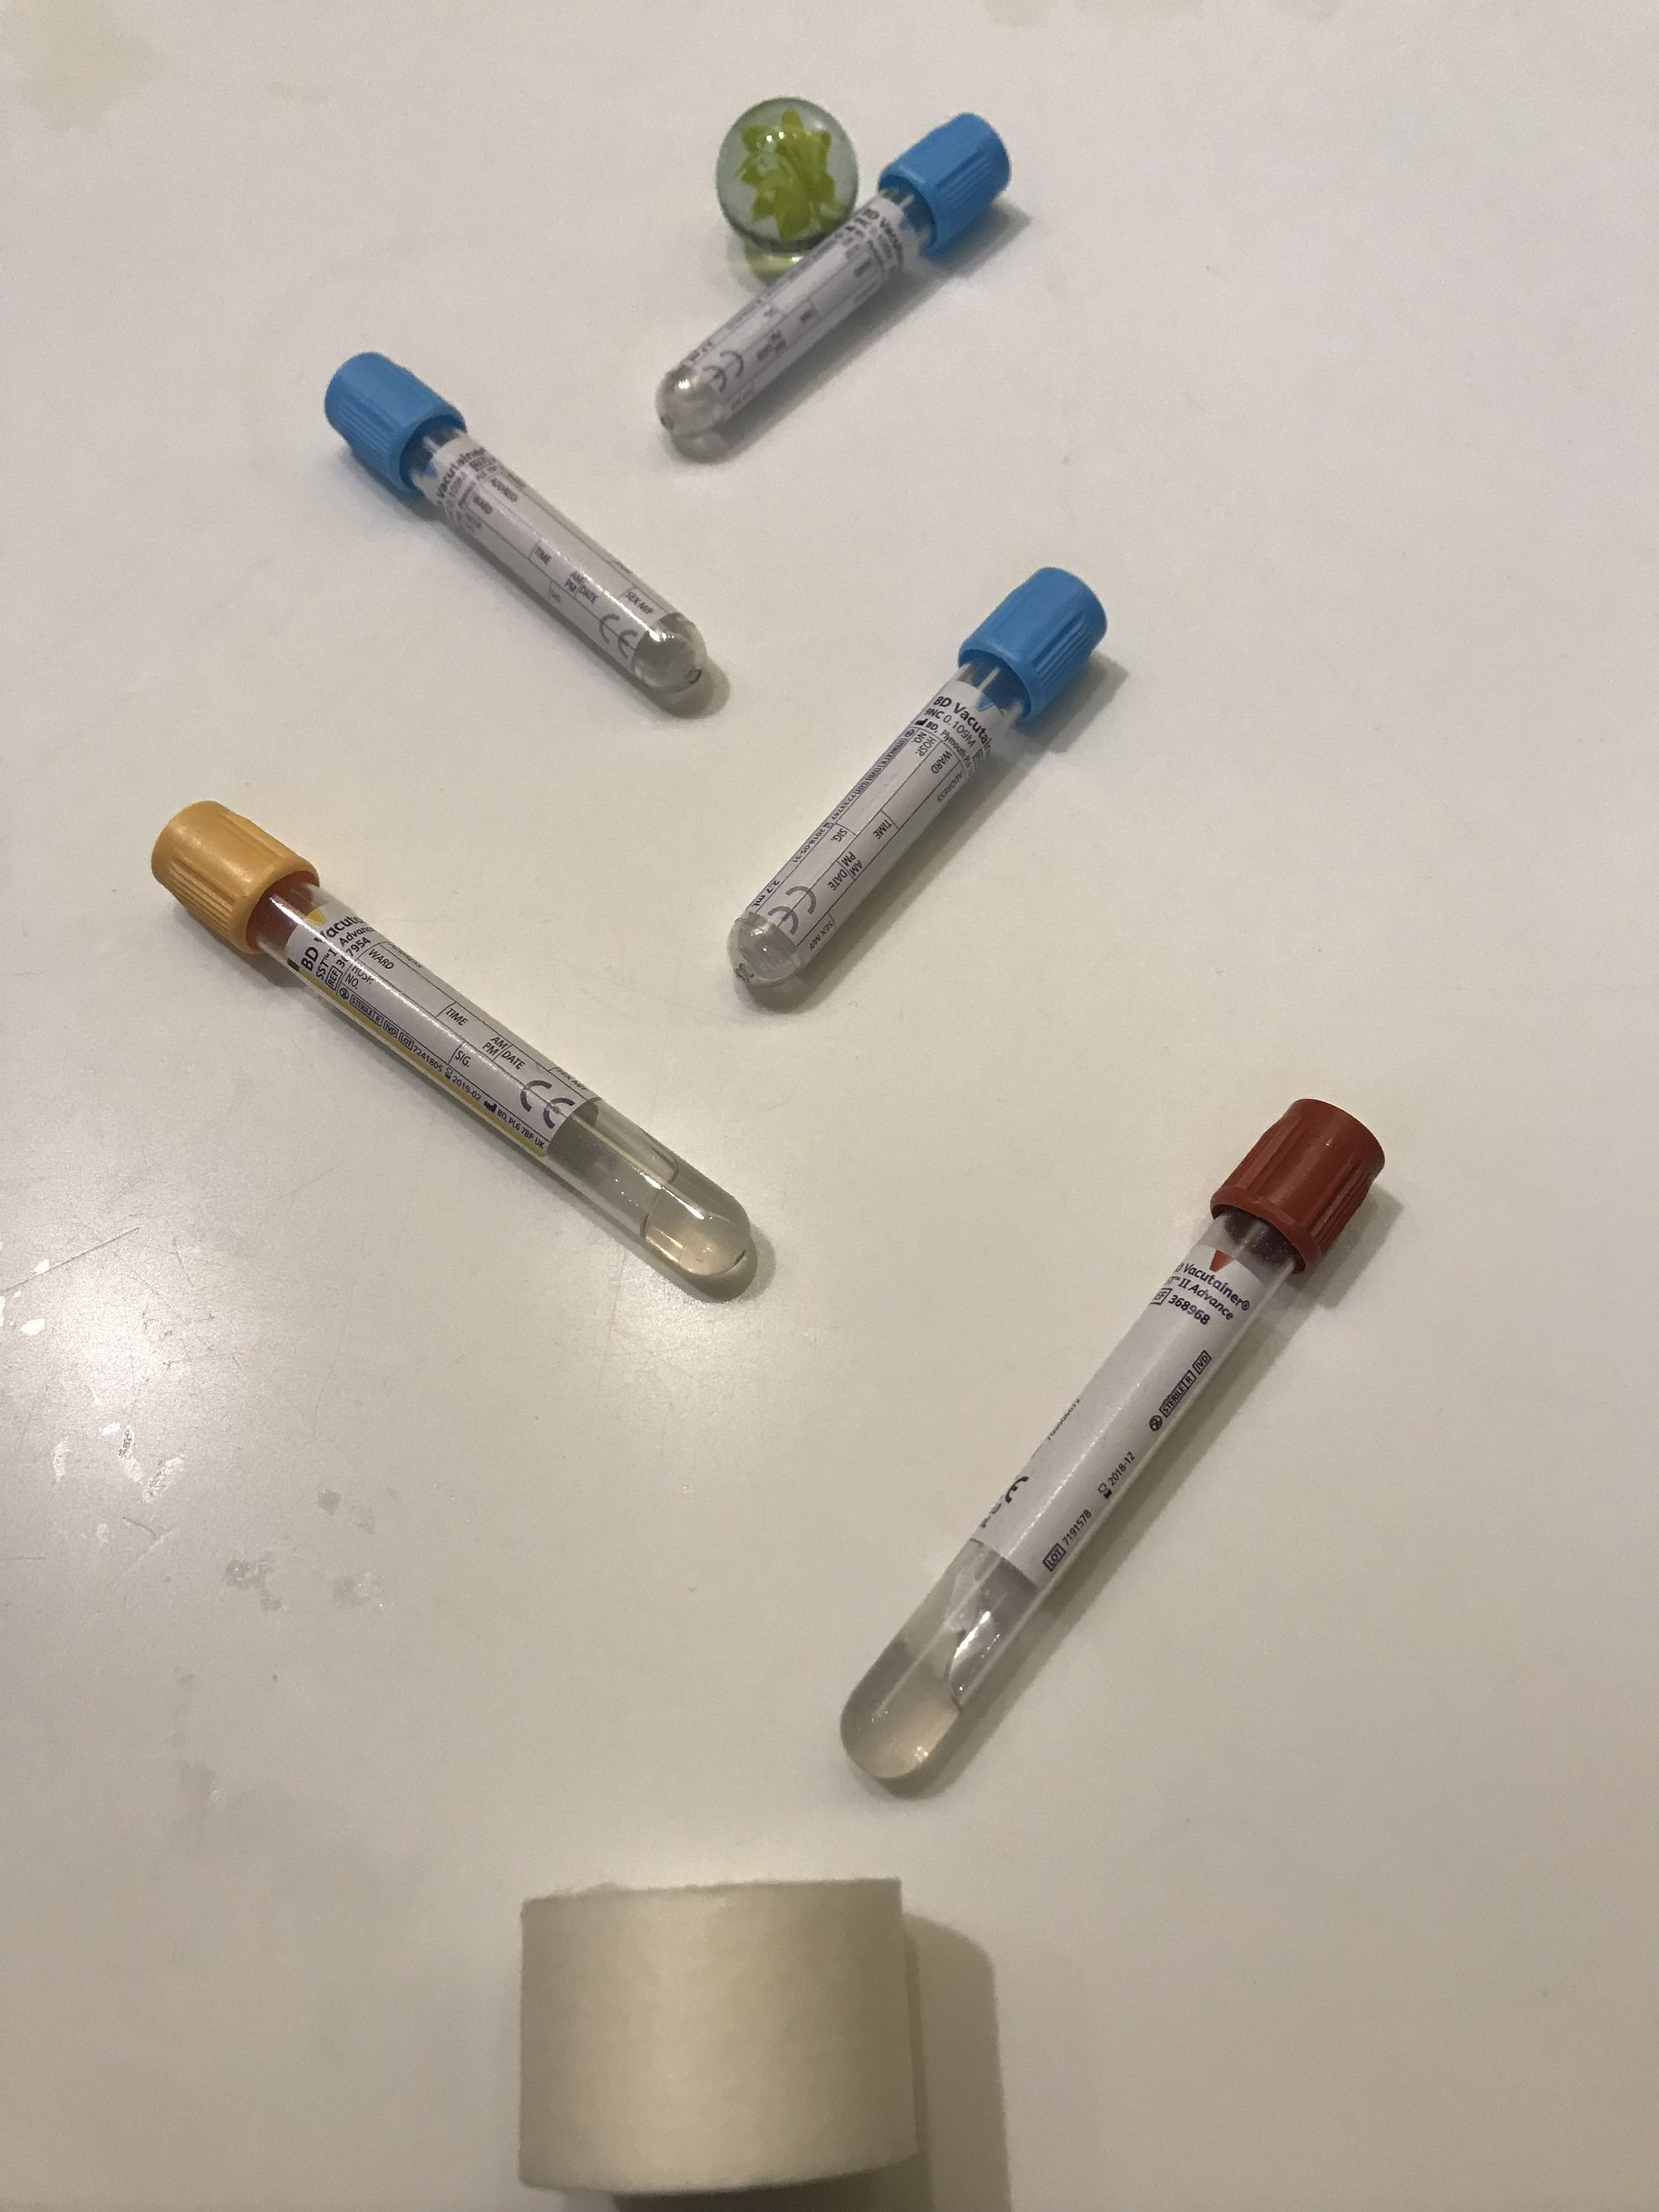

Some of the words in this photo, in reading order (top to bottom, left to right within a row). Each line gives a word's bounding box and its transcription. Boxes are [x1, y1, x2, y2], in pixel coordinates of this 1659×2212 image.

[534, 545, 552, 566] TIME
[579, 585, 598, 605] DATE
[933, 695, 951, 711] BD
[912, 732, 927, 745] NO.
[943, 714, 976, 748] 0.109M
[916, 735, 934, 758] HOSP.
[940, 729, 965, 761] Plymouth
[930, 750, 953, 774] WARD
[937, 772, 964, 803] ADDRESS
[830, 827, 848, 843] SIG.
[874, 819, 893, 840] TIME
[842, 850, 856, 865] PM
[849, 859, 863, 876] AM
[829, 868, 847, 891] DATE
[301, 945, 319, 972] BD
[368, 948, 395, 970] WARD
[327, 967, 341, 989] REF
[345, 974, 360, 990] NO.
[445, 1006, 469, 1026] TIME
[483, 1044, 499, 1058] PM
[490, 1035, 508, 1049] AM
[455, 1050, 470, 1068] SIG.
[501, 1050, 525, 1070] DATE
[401, 1035, 413, 1049] LOT
[412, 1045, 444, 1073] 7241805
[452, 1075, 481, 1102] 2019-02
[508, 1118, 522, 1133] PL6
[533, 1136, 546, 1149] UK
[1168, 1294, 1211, 1325] 368968
[1188, 1284, 1234, 1321] Advance
[1162, 1383, 1186, 1416] STERILE
[1194, 1353, 1209, 1373] IVD
[1107, 1452, 1136, 1486] 2018-12
[1045, 1545, 1064, 1571] LOT
[1062, 1509, 1092, 1545] 7191578
